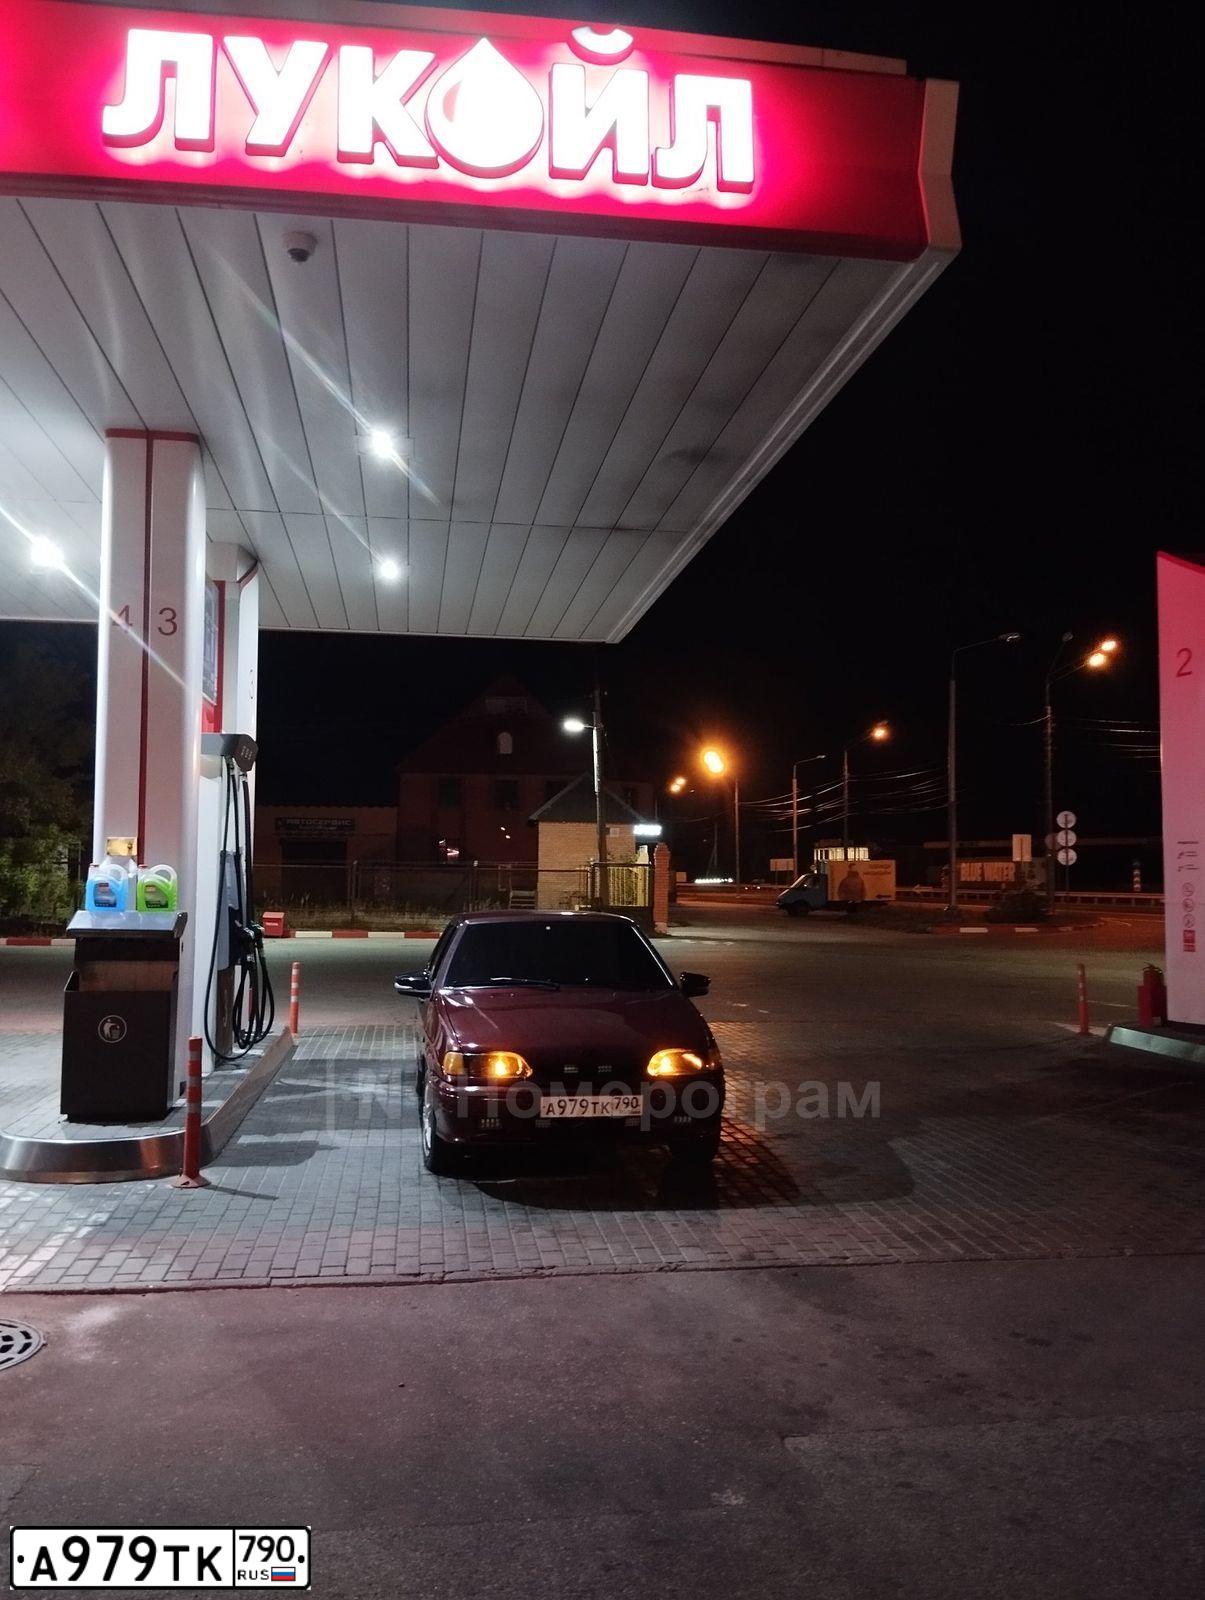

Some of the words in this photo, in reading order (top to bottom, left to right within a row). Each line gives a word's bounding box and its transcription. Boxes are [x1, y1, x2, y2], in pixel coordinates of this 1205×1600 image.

[102, 26, 755, 193] ЛУКОЙЛ
[157, 606, 178, 637] 3
[1175, 647, 1193, 678] 2
[546, 1098, 611, 1116] А979ТК
[614, 1096, 640, 1110] 790
